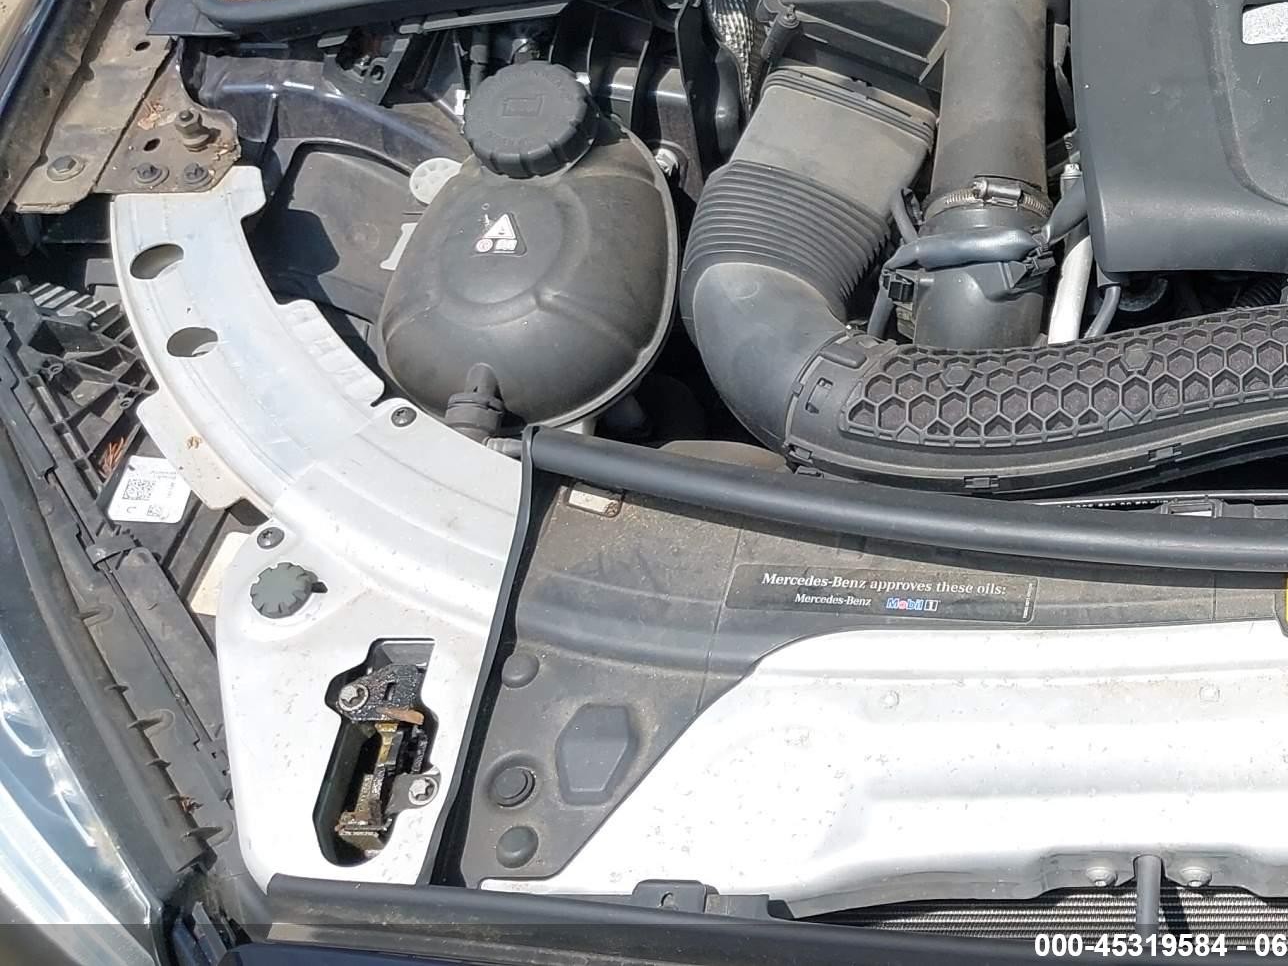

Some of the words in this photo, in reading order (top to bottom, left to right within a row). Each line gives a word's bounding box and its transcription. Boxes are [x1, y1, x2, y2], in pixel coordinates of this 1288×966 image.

[760, 572, 866, 590] Mercedes-Benz
[868, 580, 932, 593] approves
[936, 581, 974, 594] these
[976, 583, 1007, 595] oils:
[794, 593, 872, 607] Mercedes-Benz
[886, 597, 924, 611] Mobil
